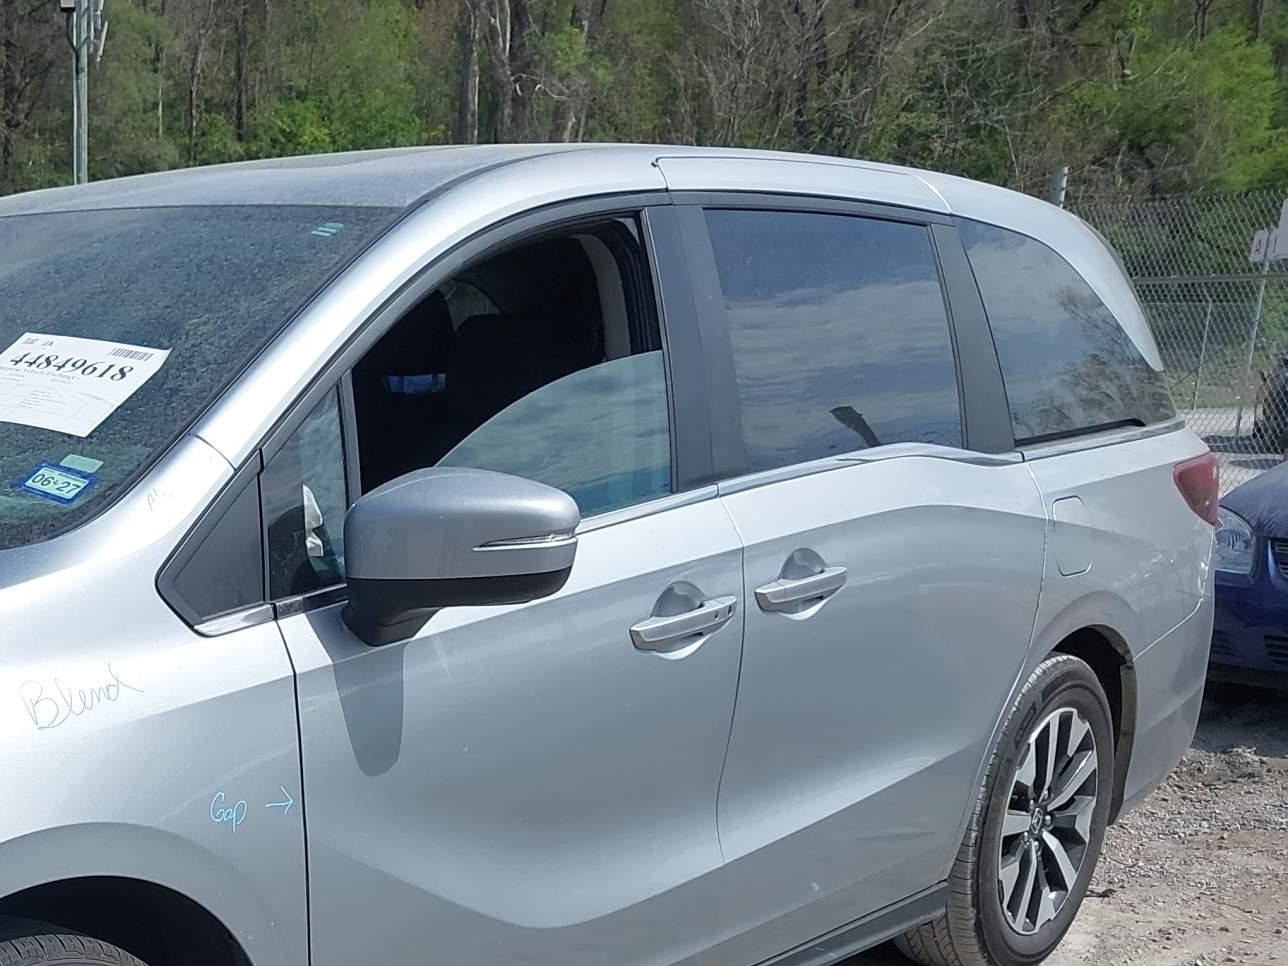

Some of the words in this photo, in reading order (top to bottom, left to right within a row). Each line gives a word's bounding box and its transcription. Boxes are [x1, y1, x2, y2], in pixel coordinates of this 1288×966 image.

[10, 352, 134, 381] 44849618
[31, 473, 54, 486] 06
[55, 481, 81, 493] 27
[19, 662, 145, 730] Blend
[210, 791, 247, 833] Gap
